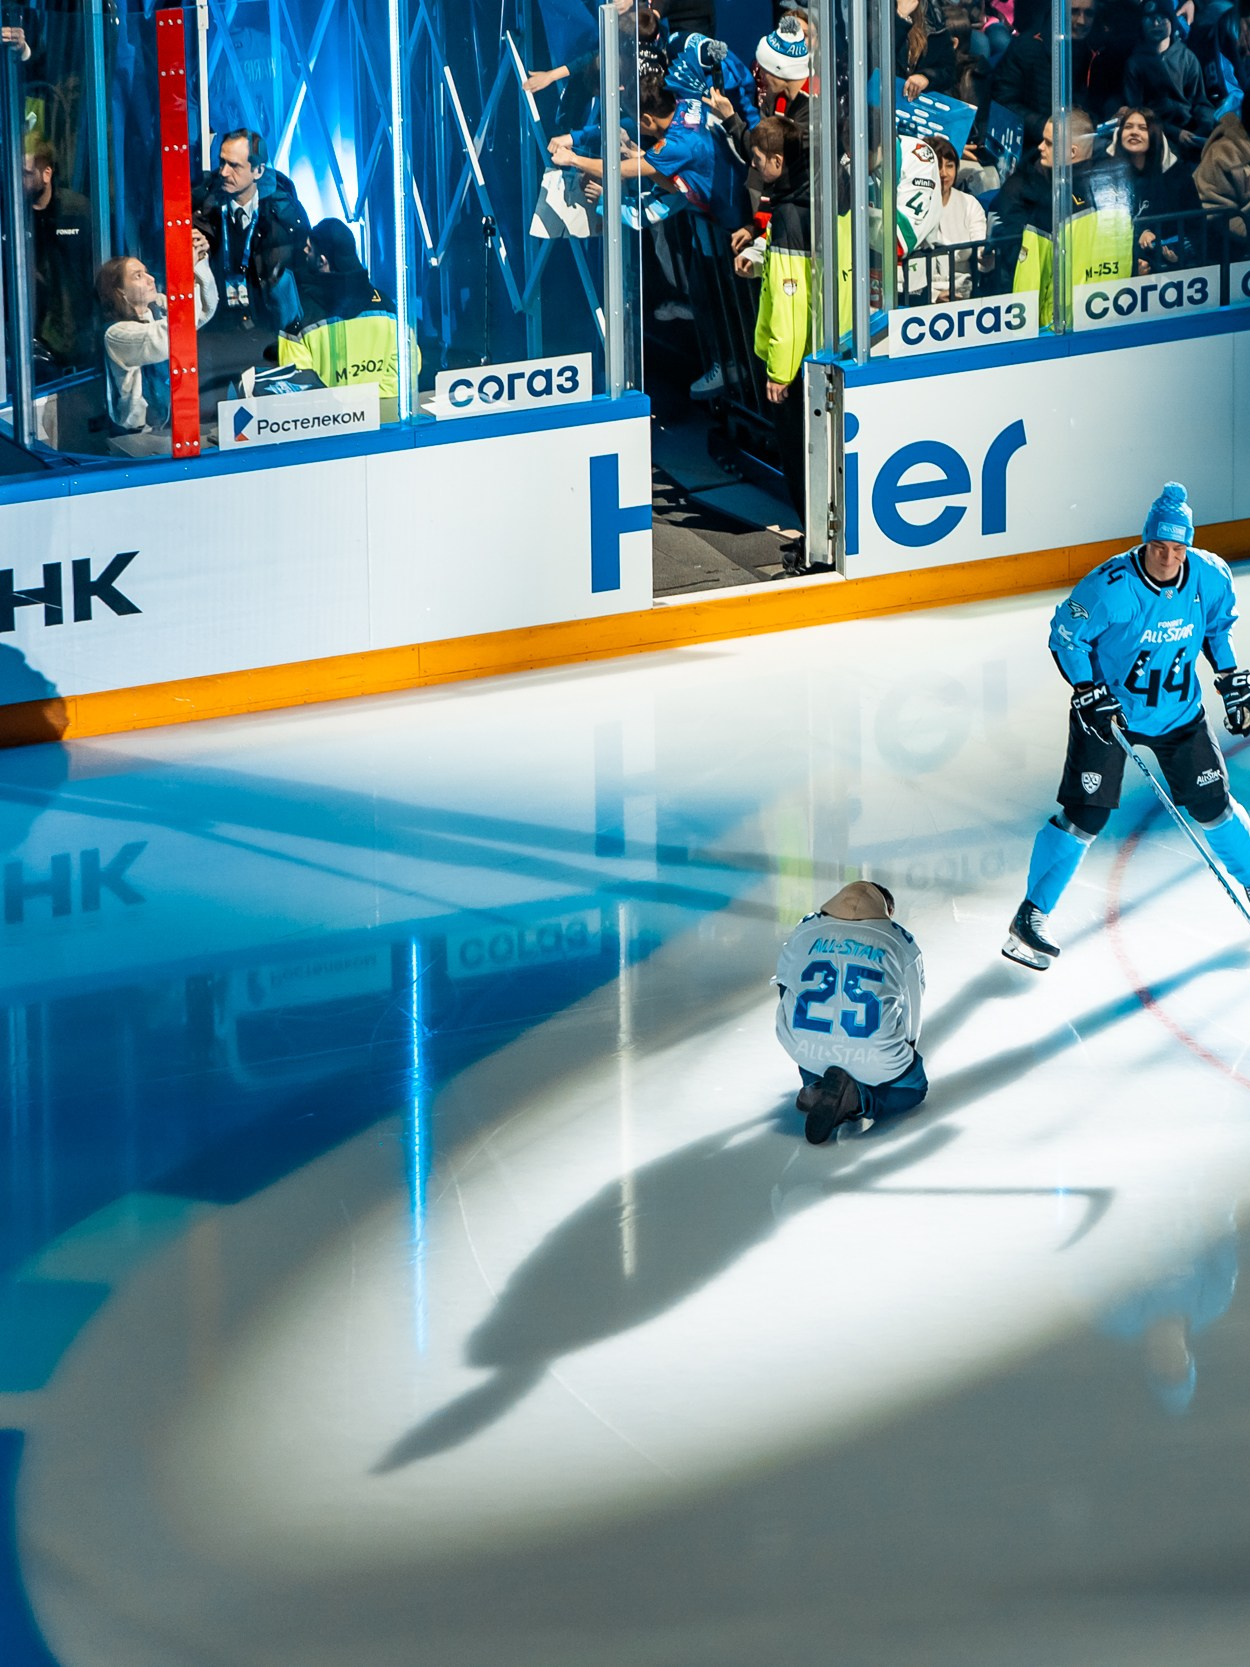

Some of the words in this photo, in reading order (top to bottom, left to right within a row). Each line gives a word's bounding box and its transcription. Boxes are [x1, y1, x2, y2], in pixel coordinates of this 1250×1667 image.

[1085, 276, 1209, 320] согаз
[901, 302, 1027, 346] согаз
[448, 364, 580, 408] согаз
[257, 409, 366, 436] Ростелеком
[1072, 685, 1108, 709] CCM
[1124, 646, 1191, 707] 44
[793, 959, 885, 1039] 25
